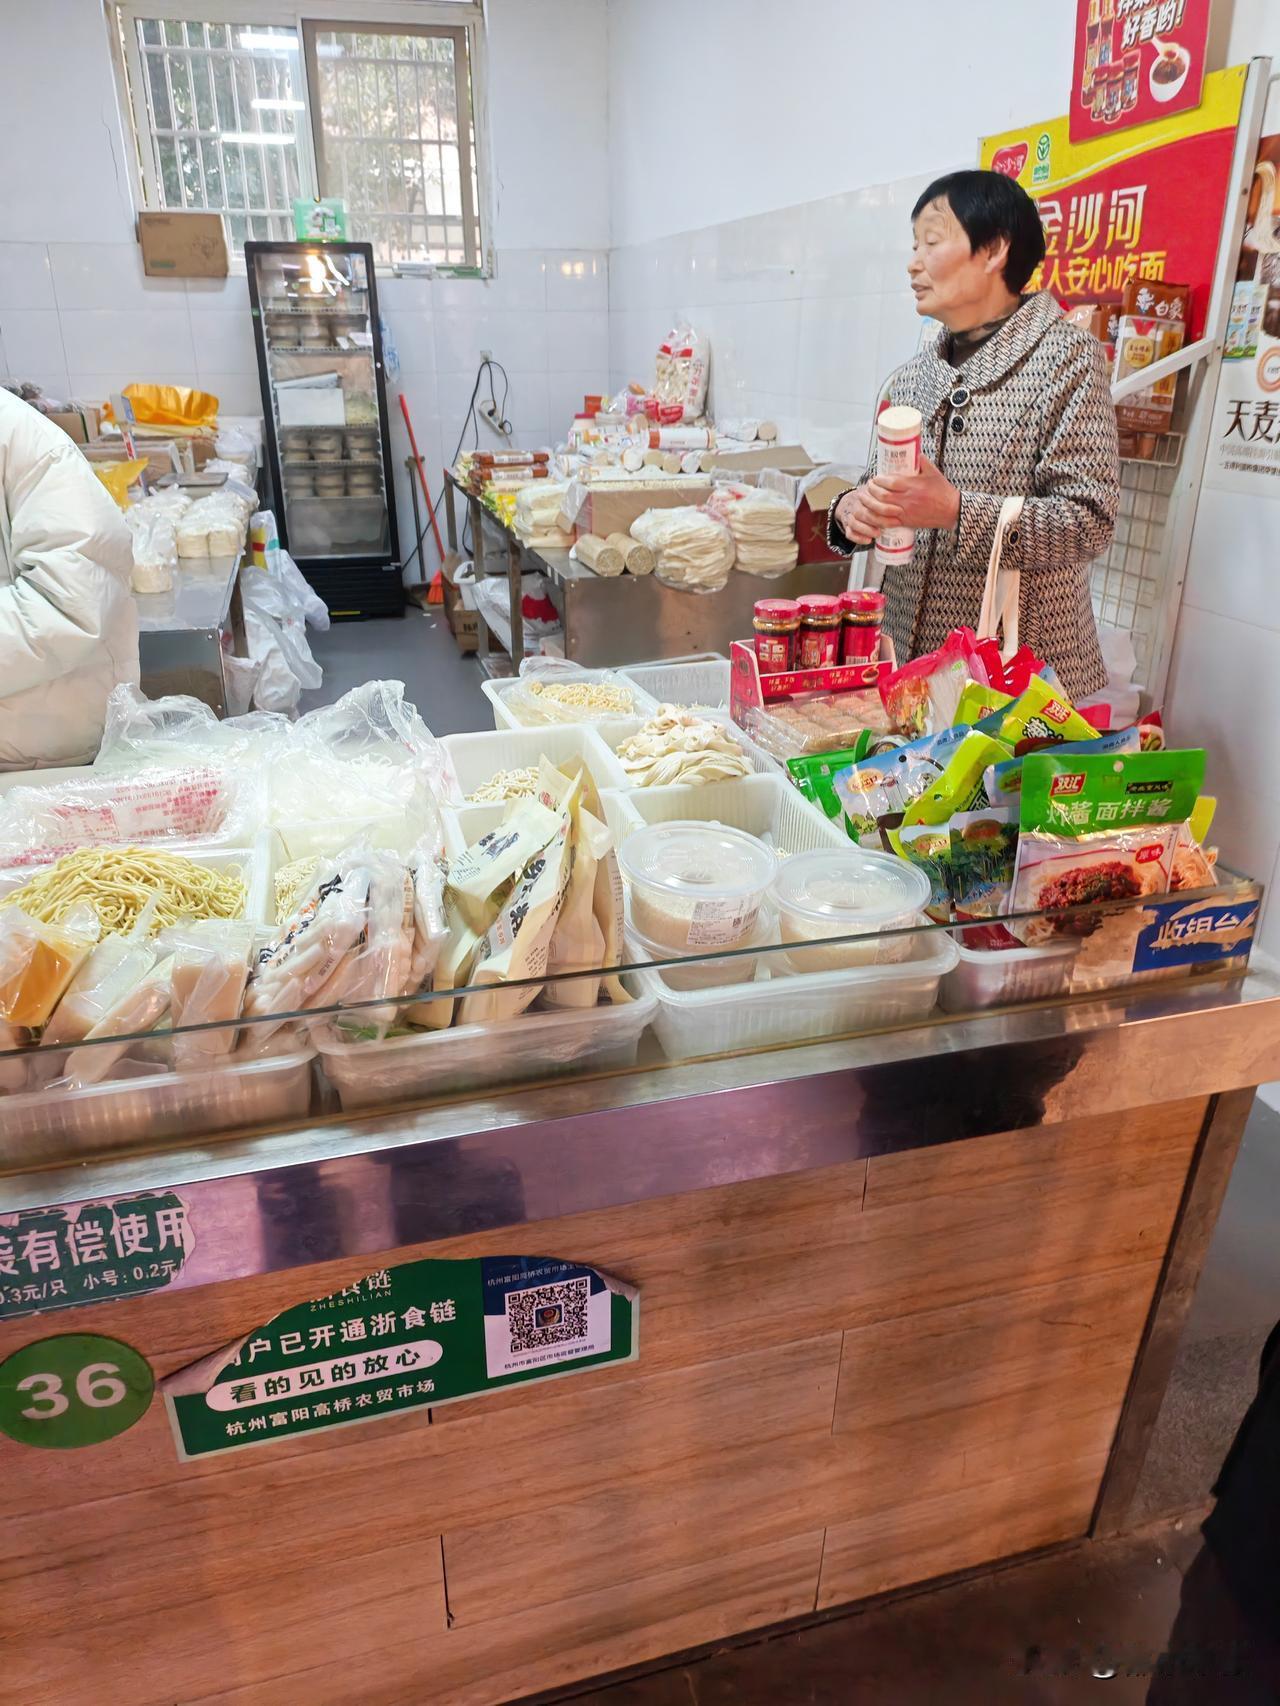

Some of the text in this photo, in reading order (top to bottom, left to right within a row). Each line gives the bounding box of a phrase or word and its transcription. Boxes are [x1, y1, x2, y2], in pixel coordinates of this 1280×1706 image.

[1155, 297, 1184, 320] 白象
[1223, 400, 1280, 445] 天麦
[1055, 775, 1082, 790] 双汇
[310, 1289, 392, 1312] ZHESHILIAN
[231, 1298, 457, 1367] 户已开通浙食链
[17, 1363, 127, 1420] 36
[230, 1348, 421, 1404] 看的见的放心
[226, 1379, 436, 1438] 杭州富阳高桥农贸市场
